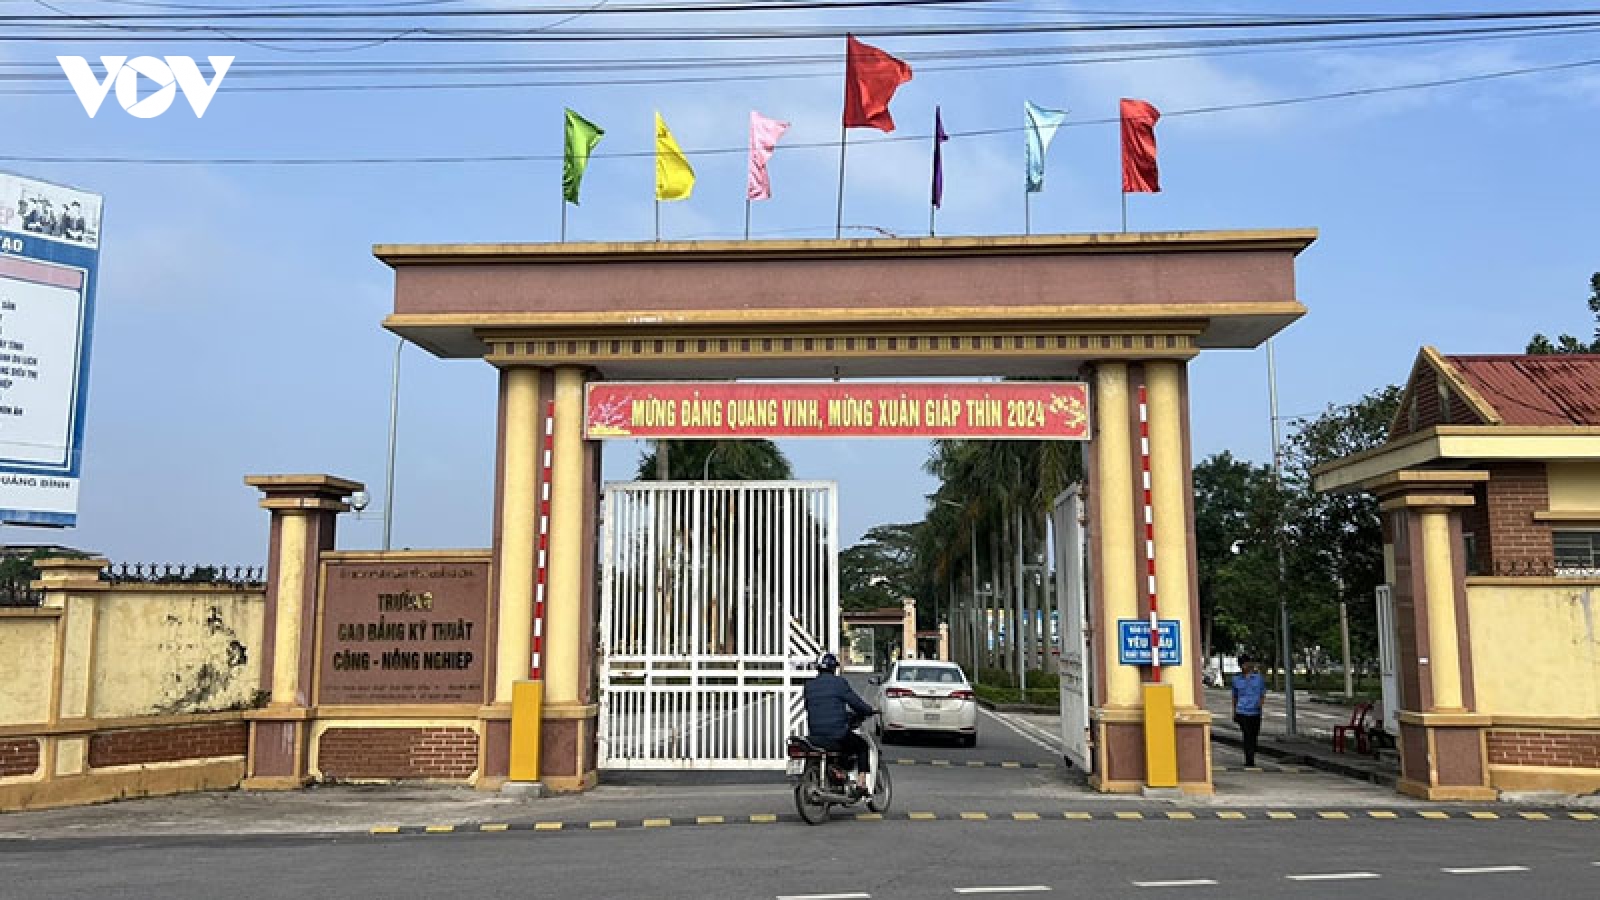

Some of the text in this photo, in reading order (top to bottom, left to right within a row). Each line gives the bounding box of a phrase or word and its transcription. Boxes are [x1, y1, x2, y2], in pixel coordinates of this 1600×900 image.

[631, 390, 1045, 430] MỪNG ĐẢNG QUANG VINH, MỪNG XUÂN GIÁP THÌN 2024
[0, 473, 37, 487] UẢNG
[337, 623, 365, 642] CAO
[333, 650, 371, 670] CÔNG
[382, 648, 419, 670] NÔNG
